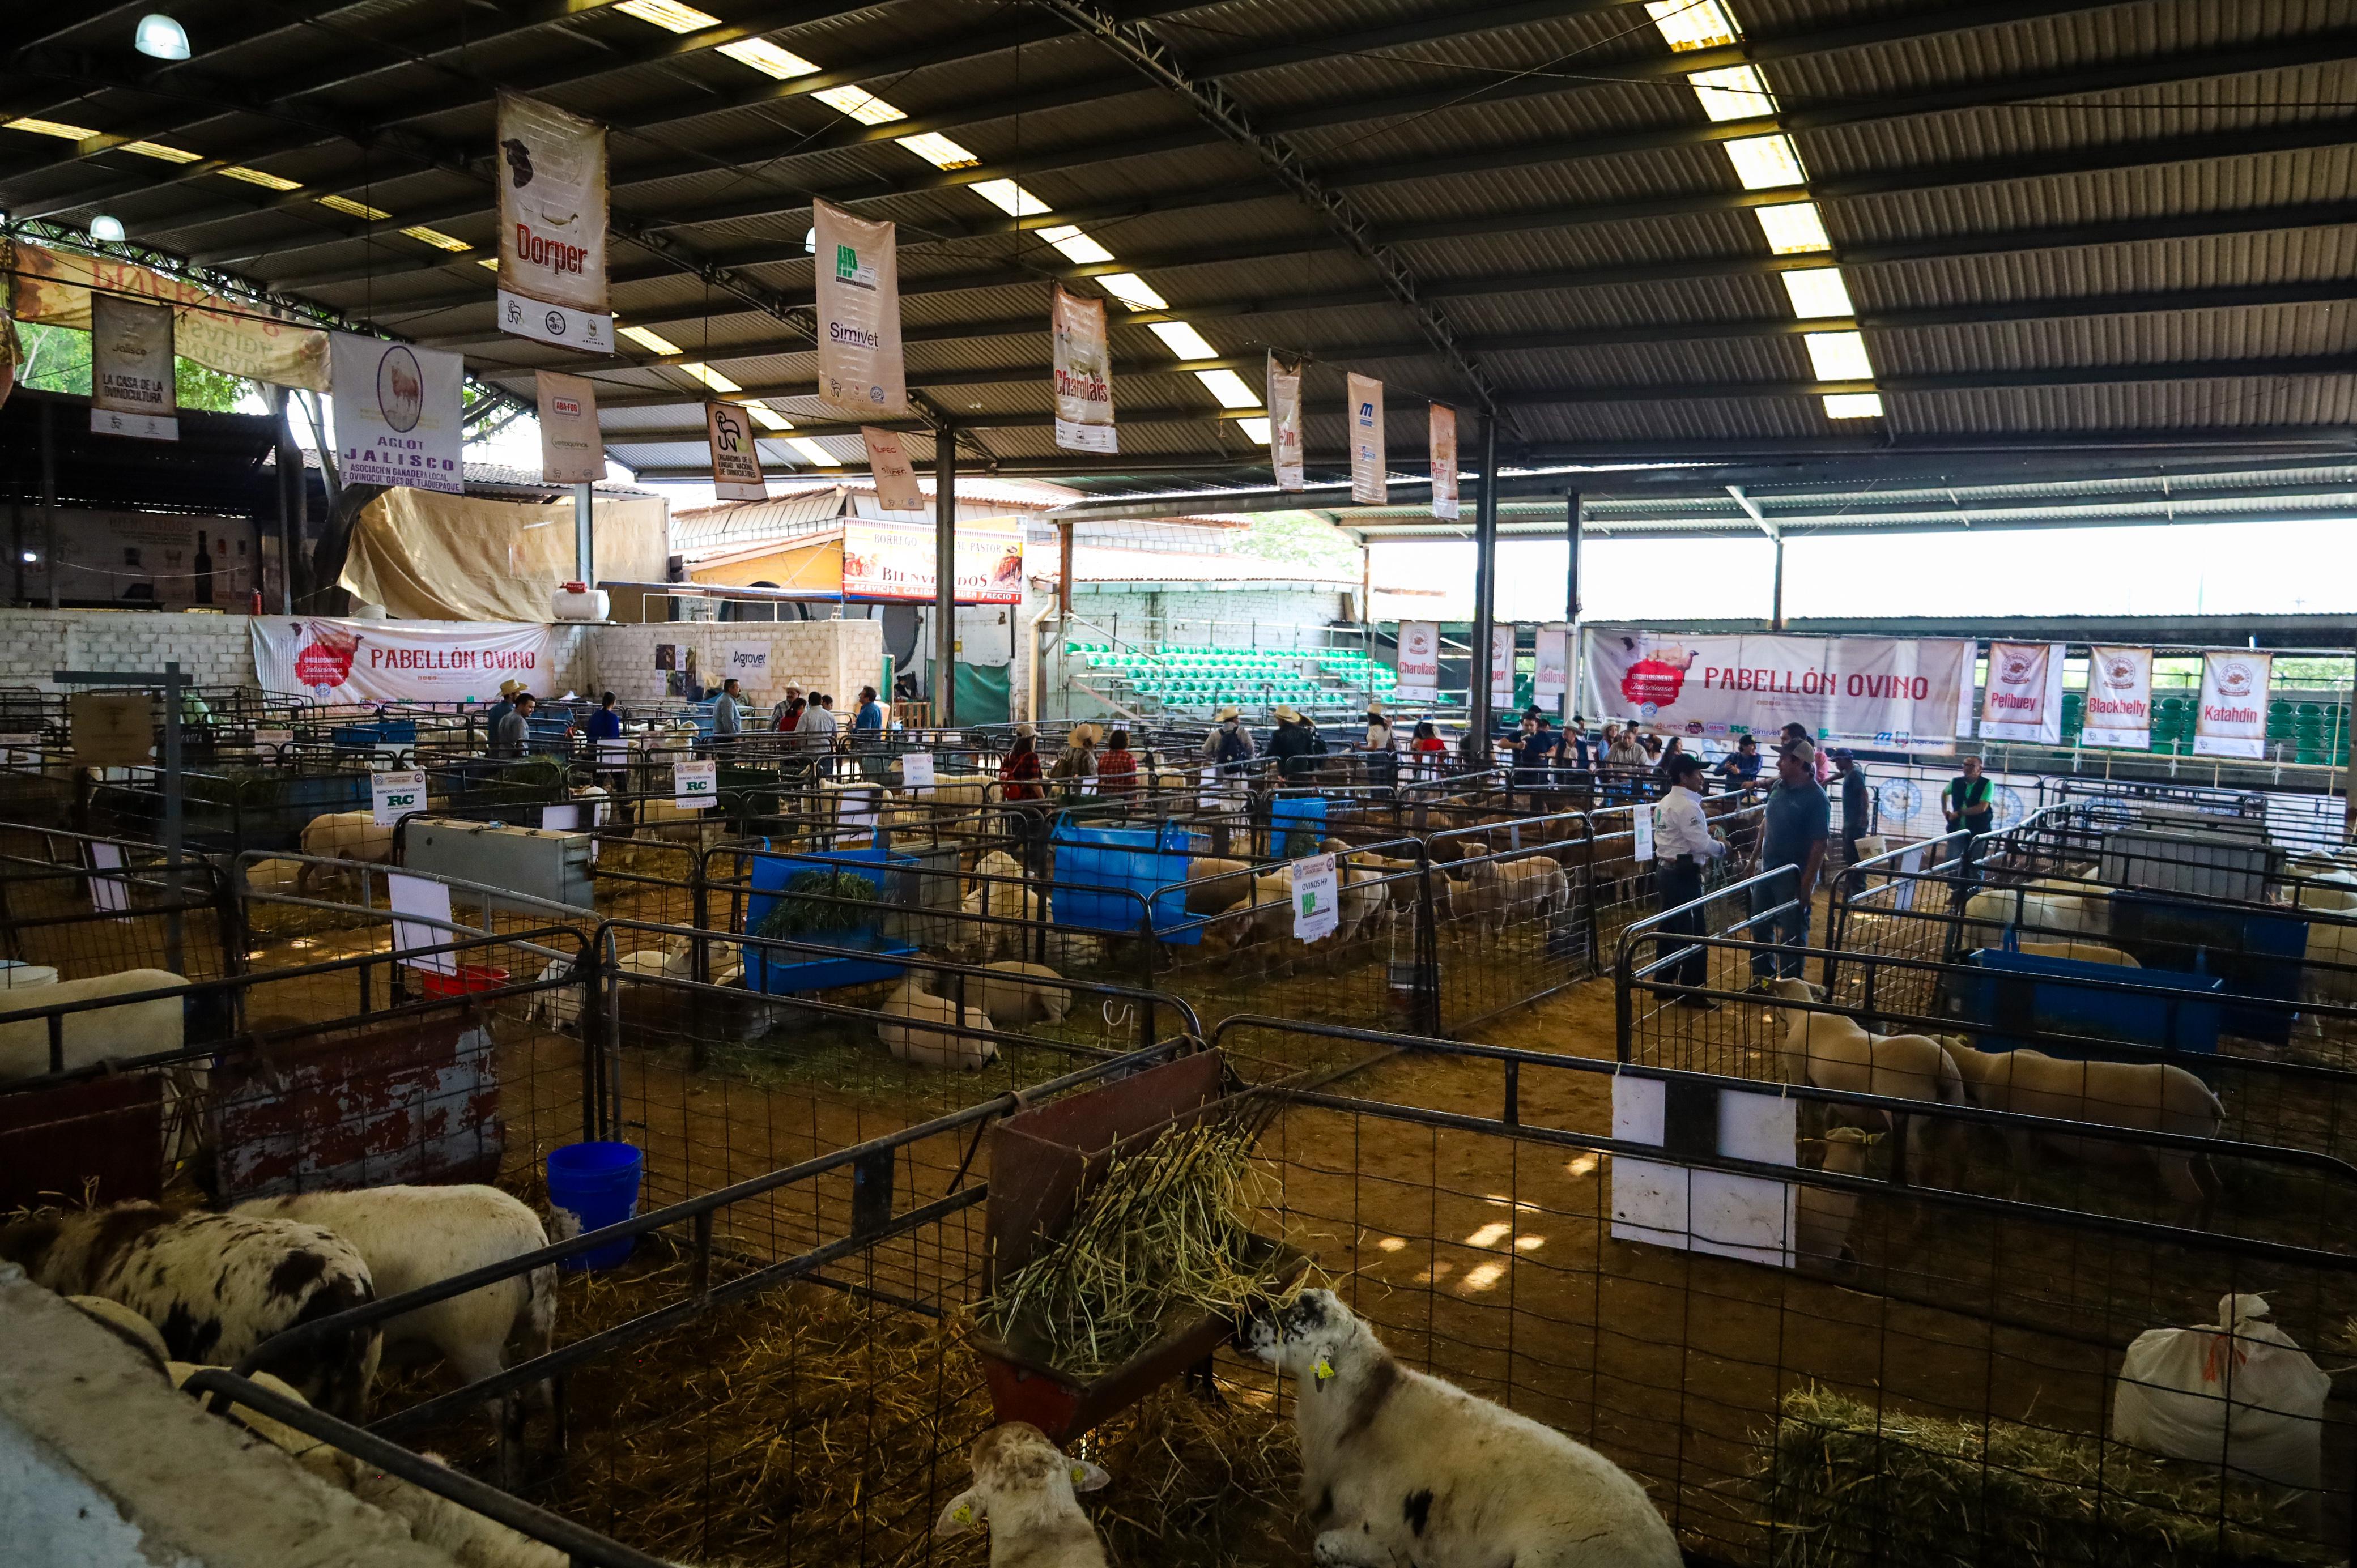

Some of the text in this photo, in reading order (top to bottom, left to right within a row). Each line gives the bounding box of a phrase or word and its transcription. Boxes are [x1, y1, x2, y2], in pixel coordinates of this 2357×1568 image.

[516, 223, 588, 275] Dorper
[830, 322, 878, 347] SimiVet
[103, 374, 163, 392] LA CASA DE LA
[1055, 369, 1108, 403] Charollais
[556, 401, 578, 412] ABA-FOR
[377, 436, 423, 450] AGLOT
[344, 448, 454, 471] JALISCO
[350, 463, 448, 482] ASOCIACIÓN GANADERA LOCAL
[405, 478, 414, 487] DE
[417, 479, 460, 491] TLAQUEPAQUE
[874, 534, 917, 547] BORREGO
[971, 543, 1001, 553] PASTOR
[903, 585, 937, 595] CALIDA
[371, 647, 535, 670] PABELLÓN OVINO
[733, 651, 766, 667] Agrovet
[1399, 661, 1436, 675] Charollais
[1704, 667, 1928, 700] PABELLÓN OVINO
[1991, 692, 2036, 711] Pelibuey
[2089, 697, 2146, 717] Blackbelly
[2204, 705, 2257, 723] Katahdin
[1730, 725, 1749, 734] RC
[686, 781, 707, 791] RC
[387, 794, 415, 806] RC
[1302, 879, 1320, 890] OVINOS
[1302, 892, 1316, 915] HP
